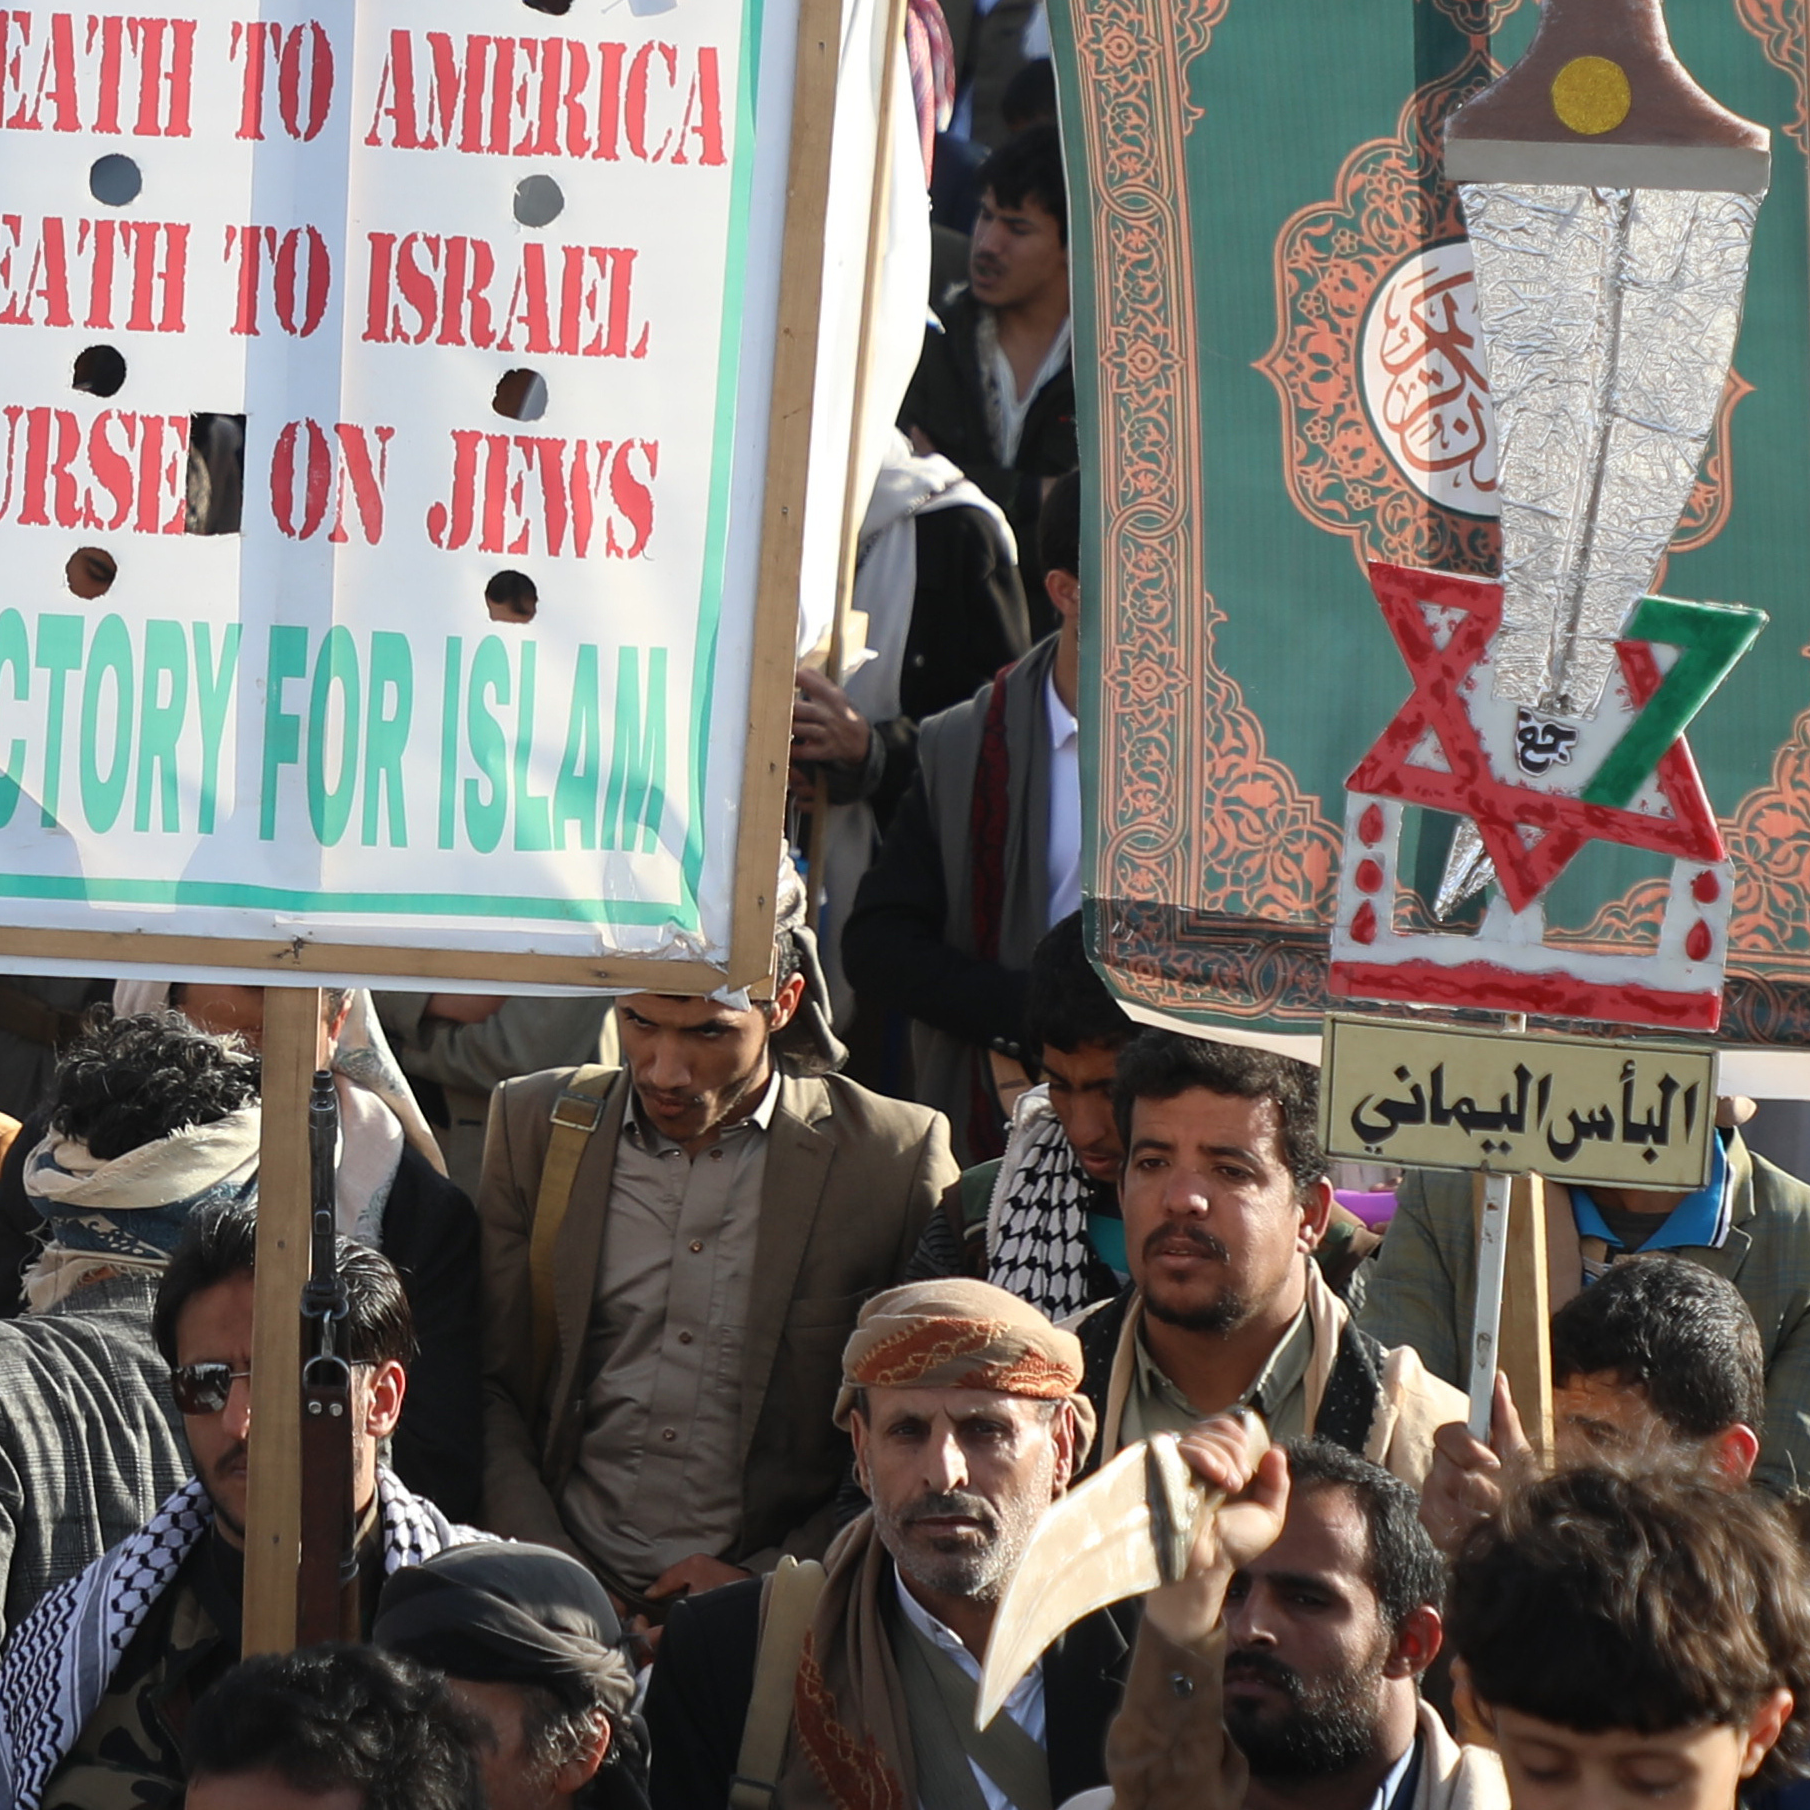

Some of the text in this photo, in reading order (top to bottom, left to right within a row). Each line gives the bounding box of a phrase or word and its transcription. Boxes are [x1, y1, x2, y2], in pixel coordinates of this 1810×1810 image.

[228, 16, 338, 145] TO
[363, 27, 728, 169] AMERICA
[222, 221, 331, 340] TO
[361, 230, 652, 362] ISRAEL
[269, 416, 395, 547] ON
[426, 427, 661, 561] JEWS
[258, 621, 411, 851] FOR
[438, 632, 669, 859] ISLAM
[1350, 1059, 1700, 1164] البأس اليماني
